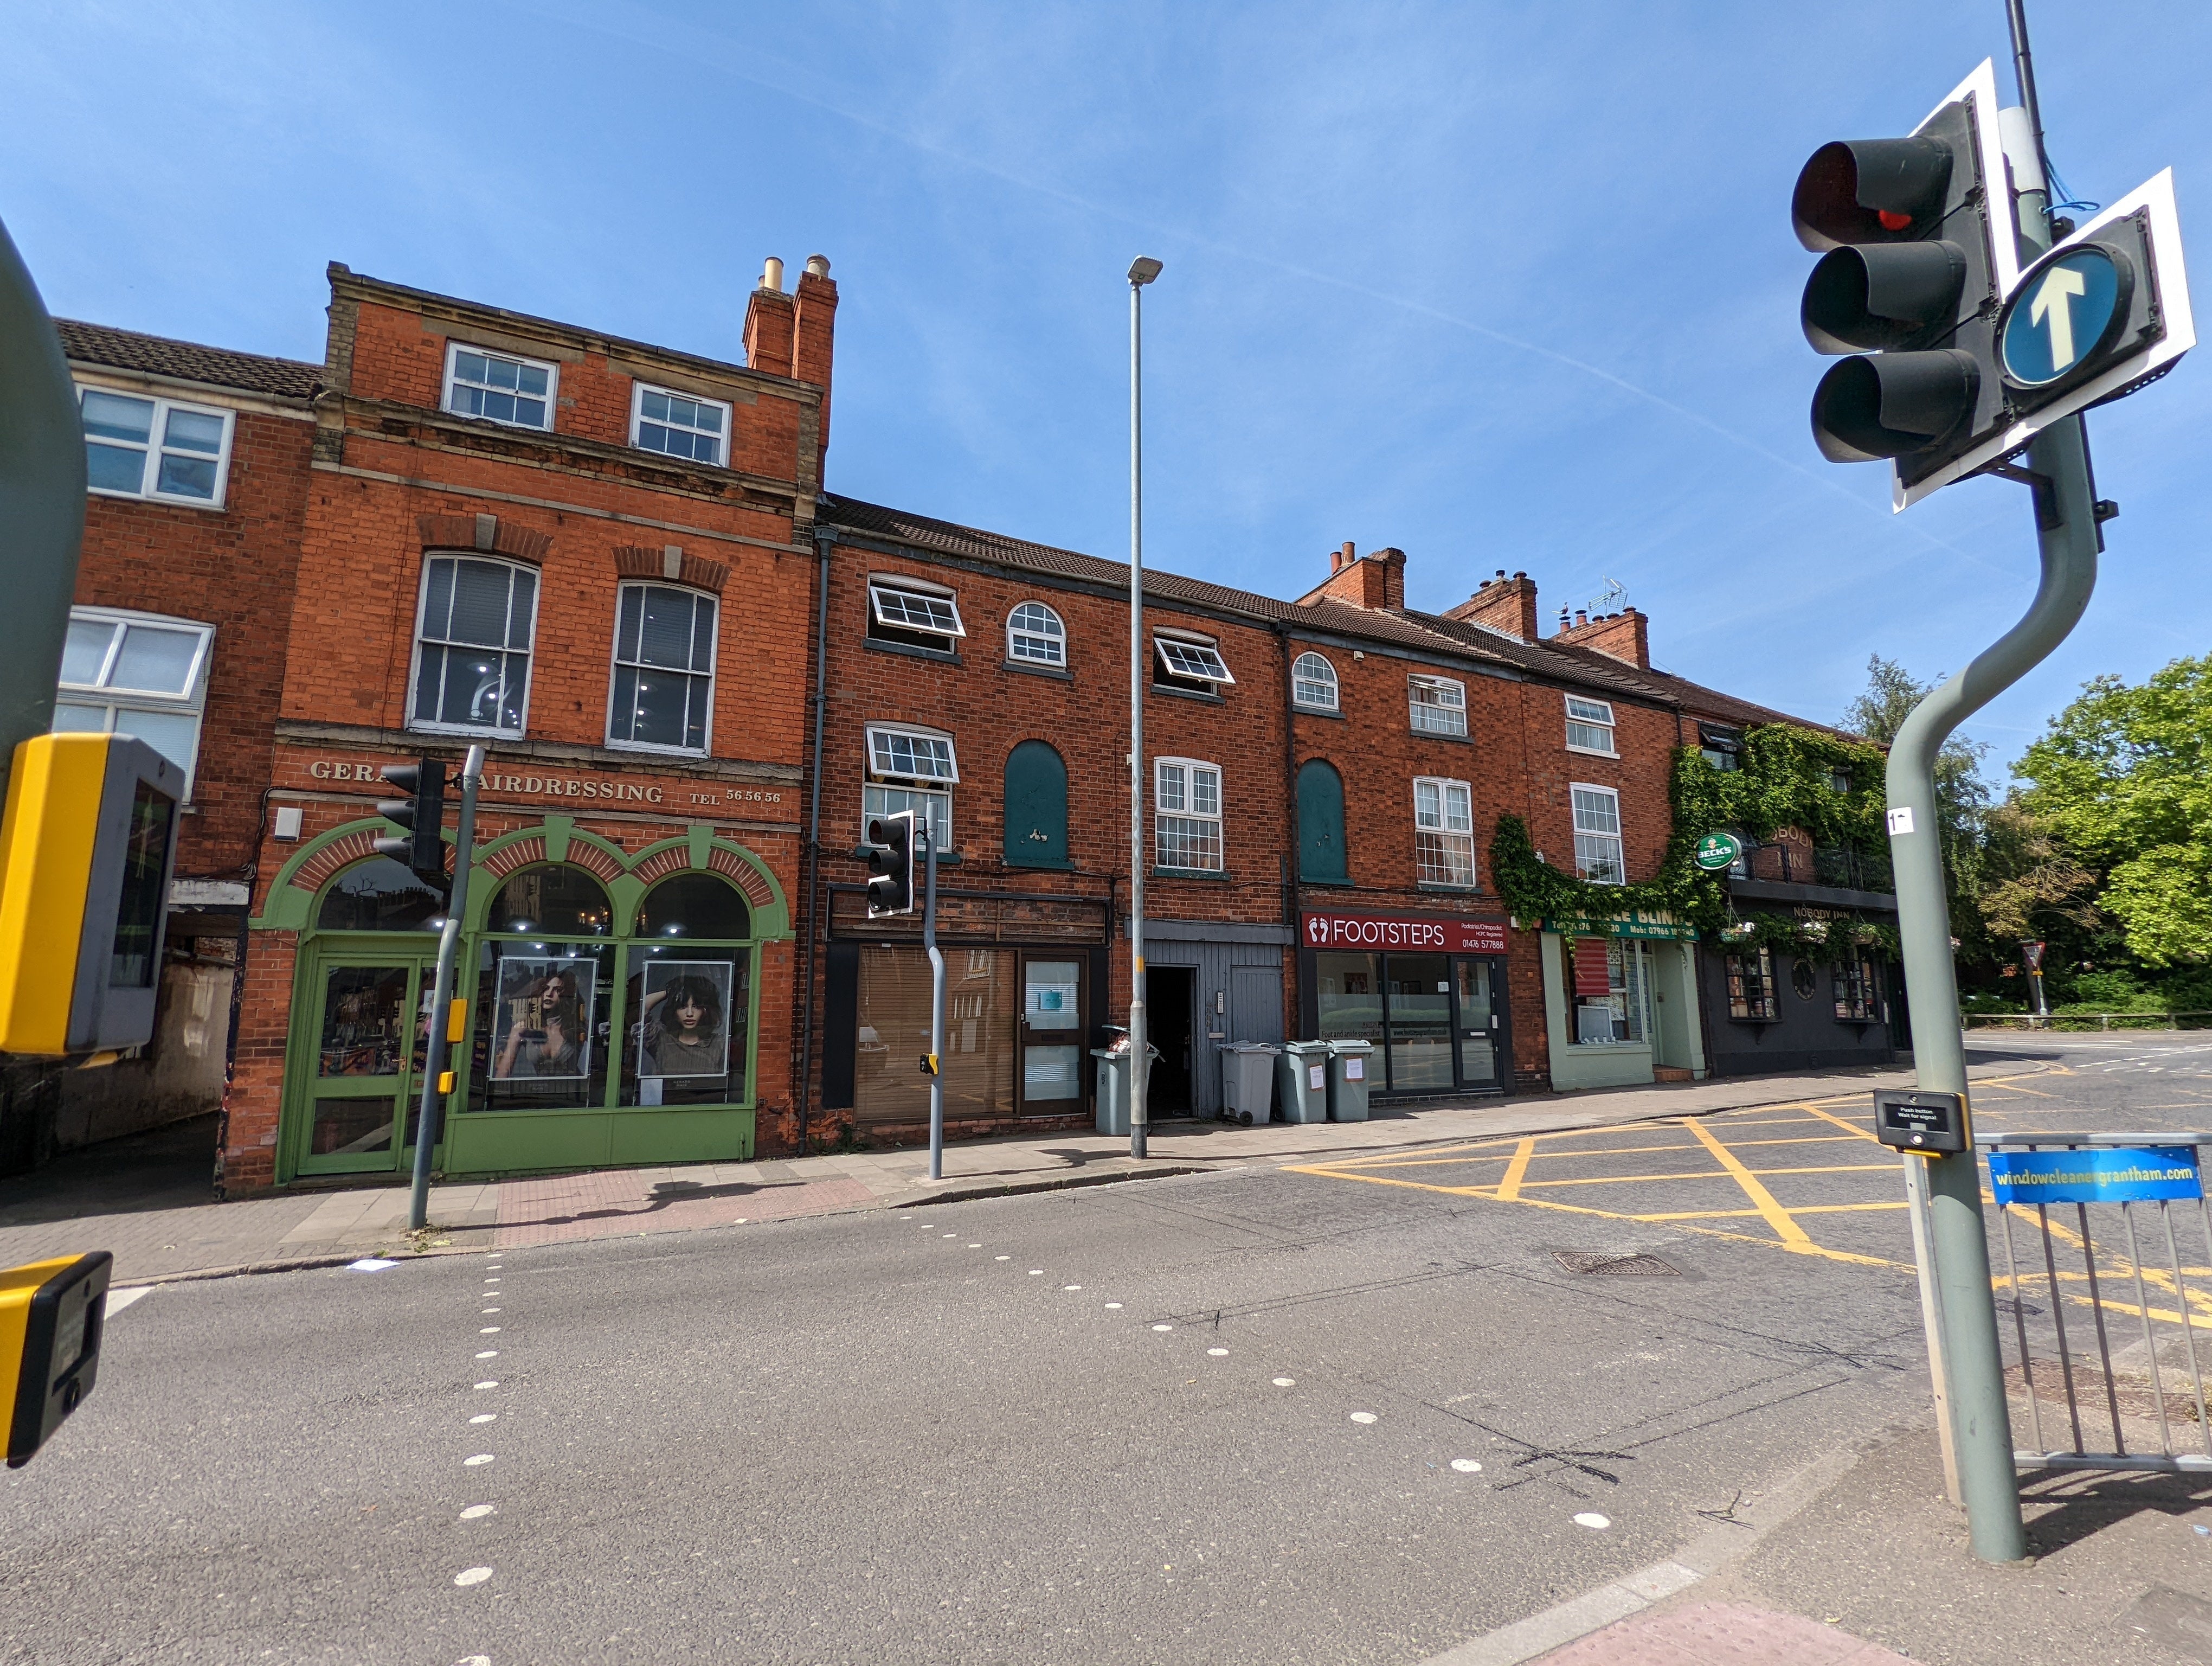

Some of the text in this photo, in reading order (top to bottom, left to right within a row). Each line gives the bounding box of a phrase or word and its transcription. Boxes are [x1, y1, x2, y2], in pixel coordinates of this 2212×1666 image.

[690, 790, 781, 805] TEL 56 56 56
[1697, 846, 1732, 858] BECK'S
[1637, 909, 1694, 926] BLIN
[1334, 920, 1445, 946] FOOTSTEPS
[1630, 925, 1647, 934] Mob:
[1648, 926, 1669, 935] 07966
[1670, 928, 1695, 937] 1840
[1462, 939, 1504, 949] 01476 577888
